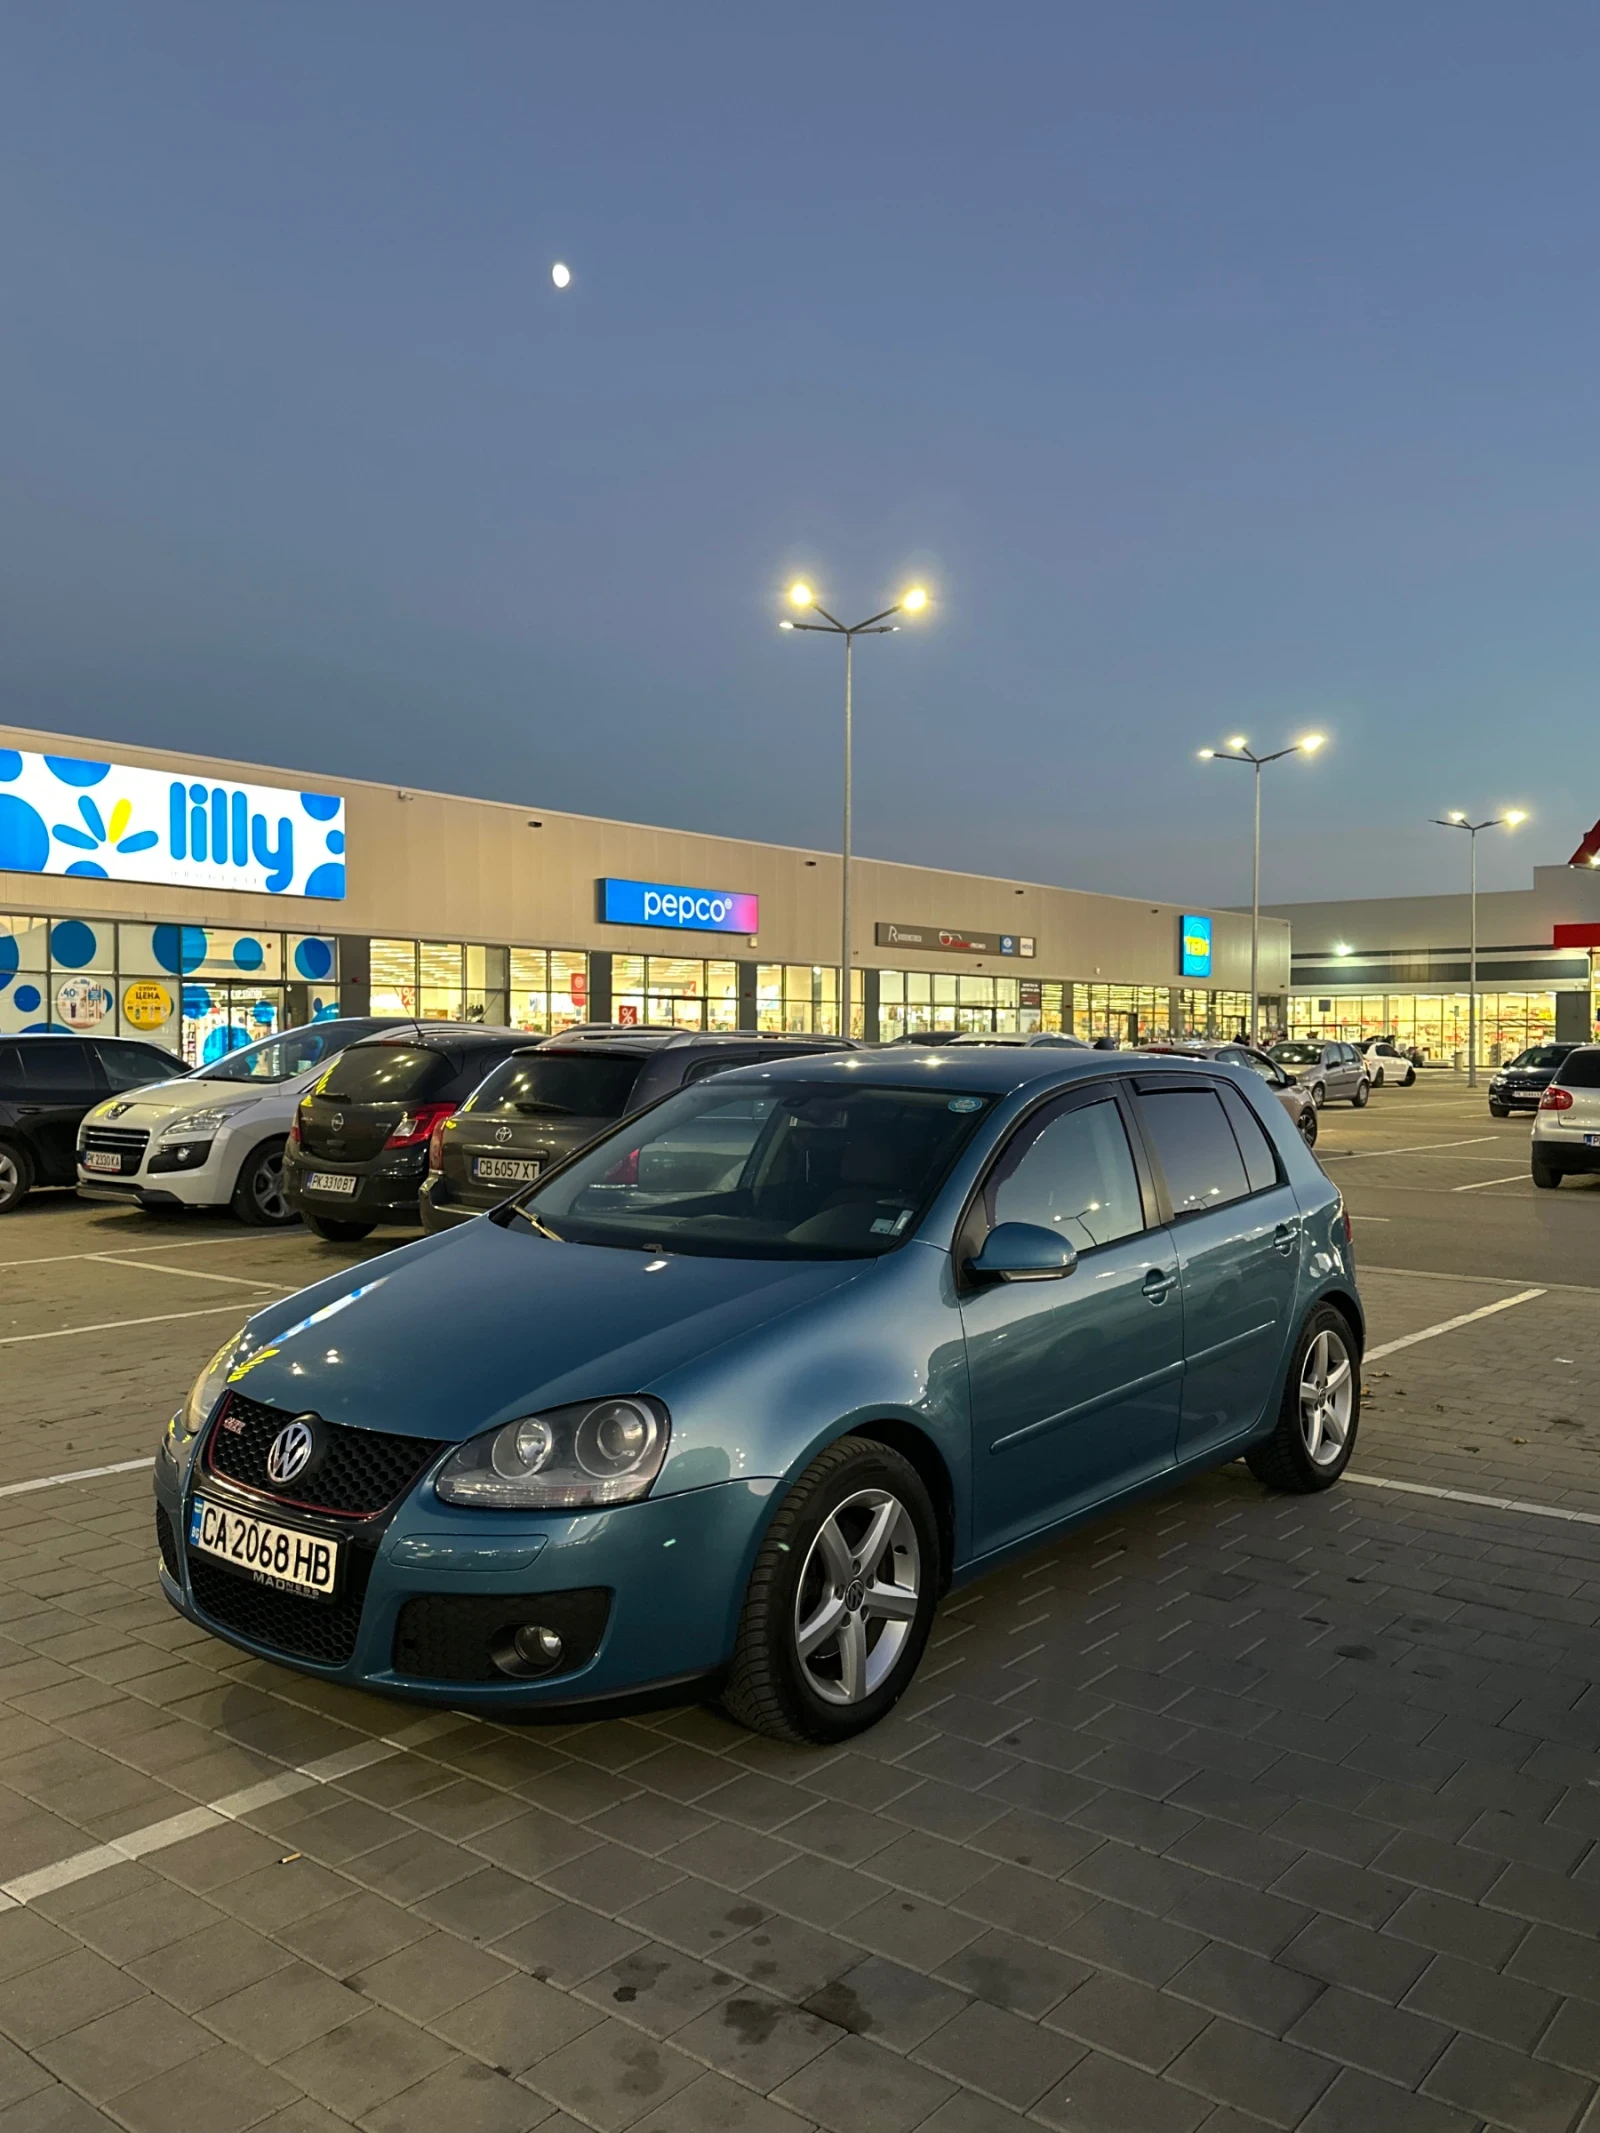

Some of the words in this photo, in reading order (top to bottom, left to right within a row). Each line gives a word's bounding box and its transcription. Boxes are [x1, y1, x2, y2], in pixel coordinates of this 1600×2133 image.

[169, 781, 294, 893] lilly
[135, 991, 161, 1000] ЦЕНА
[479, 1160, 493, 1176] CB
[494, 1161, 520, 1178] 6057
[522, 1163, 538, 1180] XT
[311, 1174, 323, 1188] PK
[323, 1175, 342, 1190] 3310
[342, 1177, 355, 1191] BT
[202, 1507, 228, 1553] CA
[231, 1519, 290, 1574] 2068
[293, 1538, 331, 1587] HB
